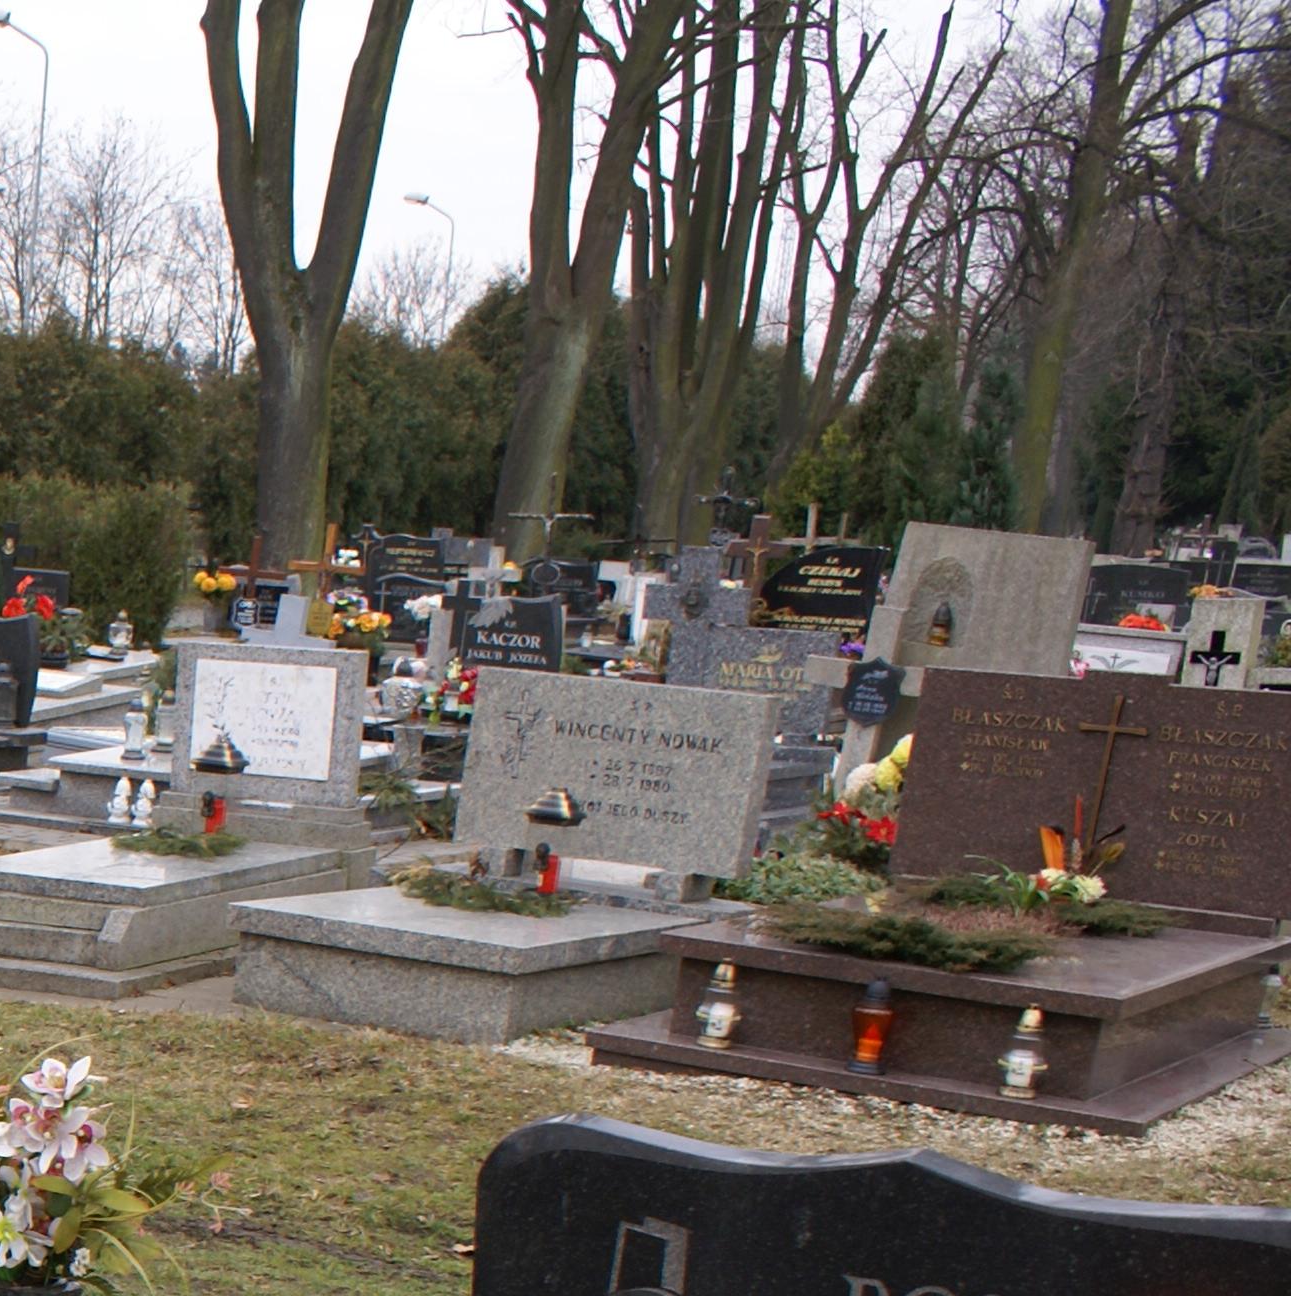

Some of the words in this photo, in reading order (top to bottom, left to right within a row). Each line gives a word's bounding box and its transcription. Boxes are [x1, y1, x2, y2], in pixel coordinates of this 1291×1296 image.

[476, 630, 541, 649] KACZOR
[467, 649, 503, 661] JAKUB
[721, 661, 773, 680] MARIA
[554, 720, 651, 745] WINCENTY
[658, 732, 723, 753] NOWAK
[1159, 726, 1288, 751] BŁASZCZAK
[1168, 751, 1272, 772] FRANCISZEK
[1177, 832, 1227, 849] ZOFIA
